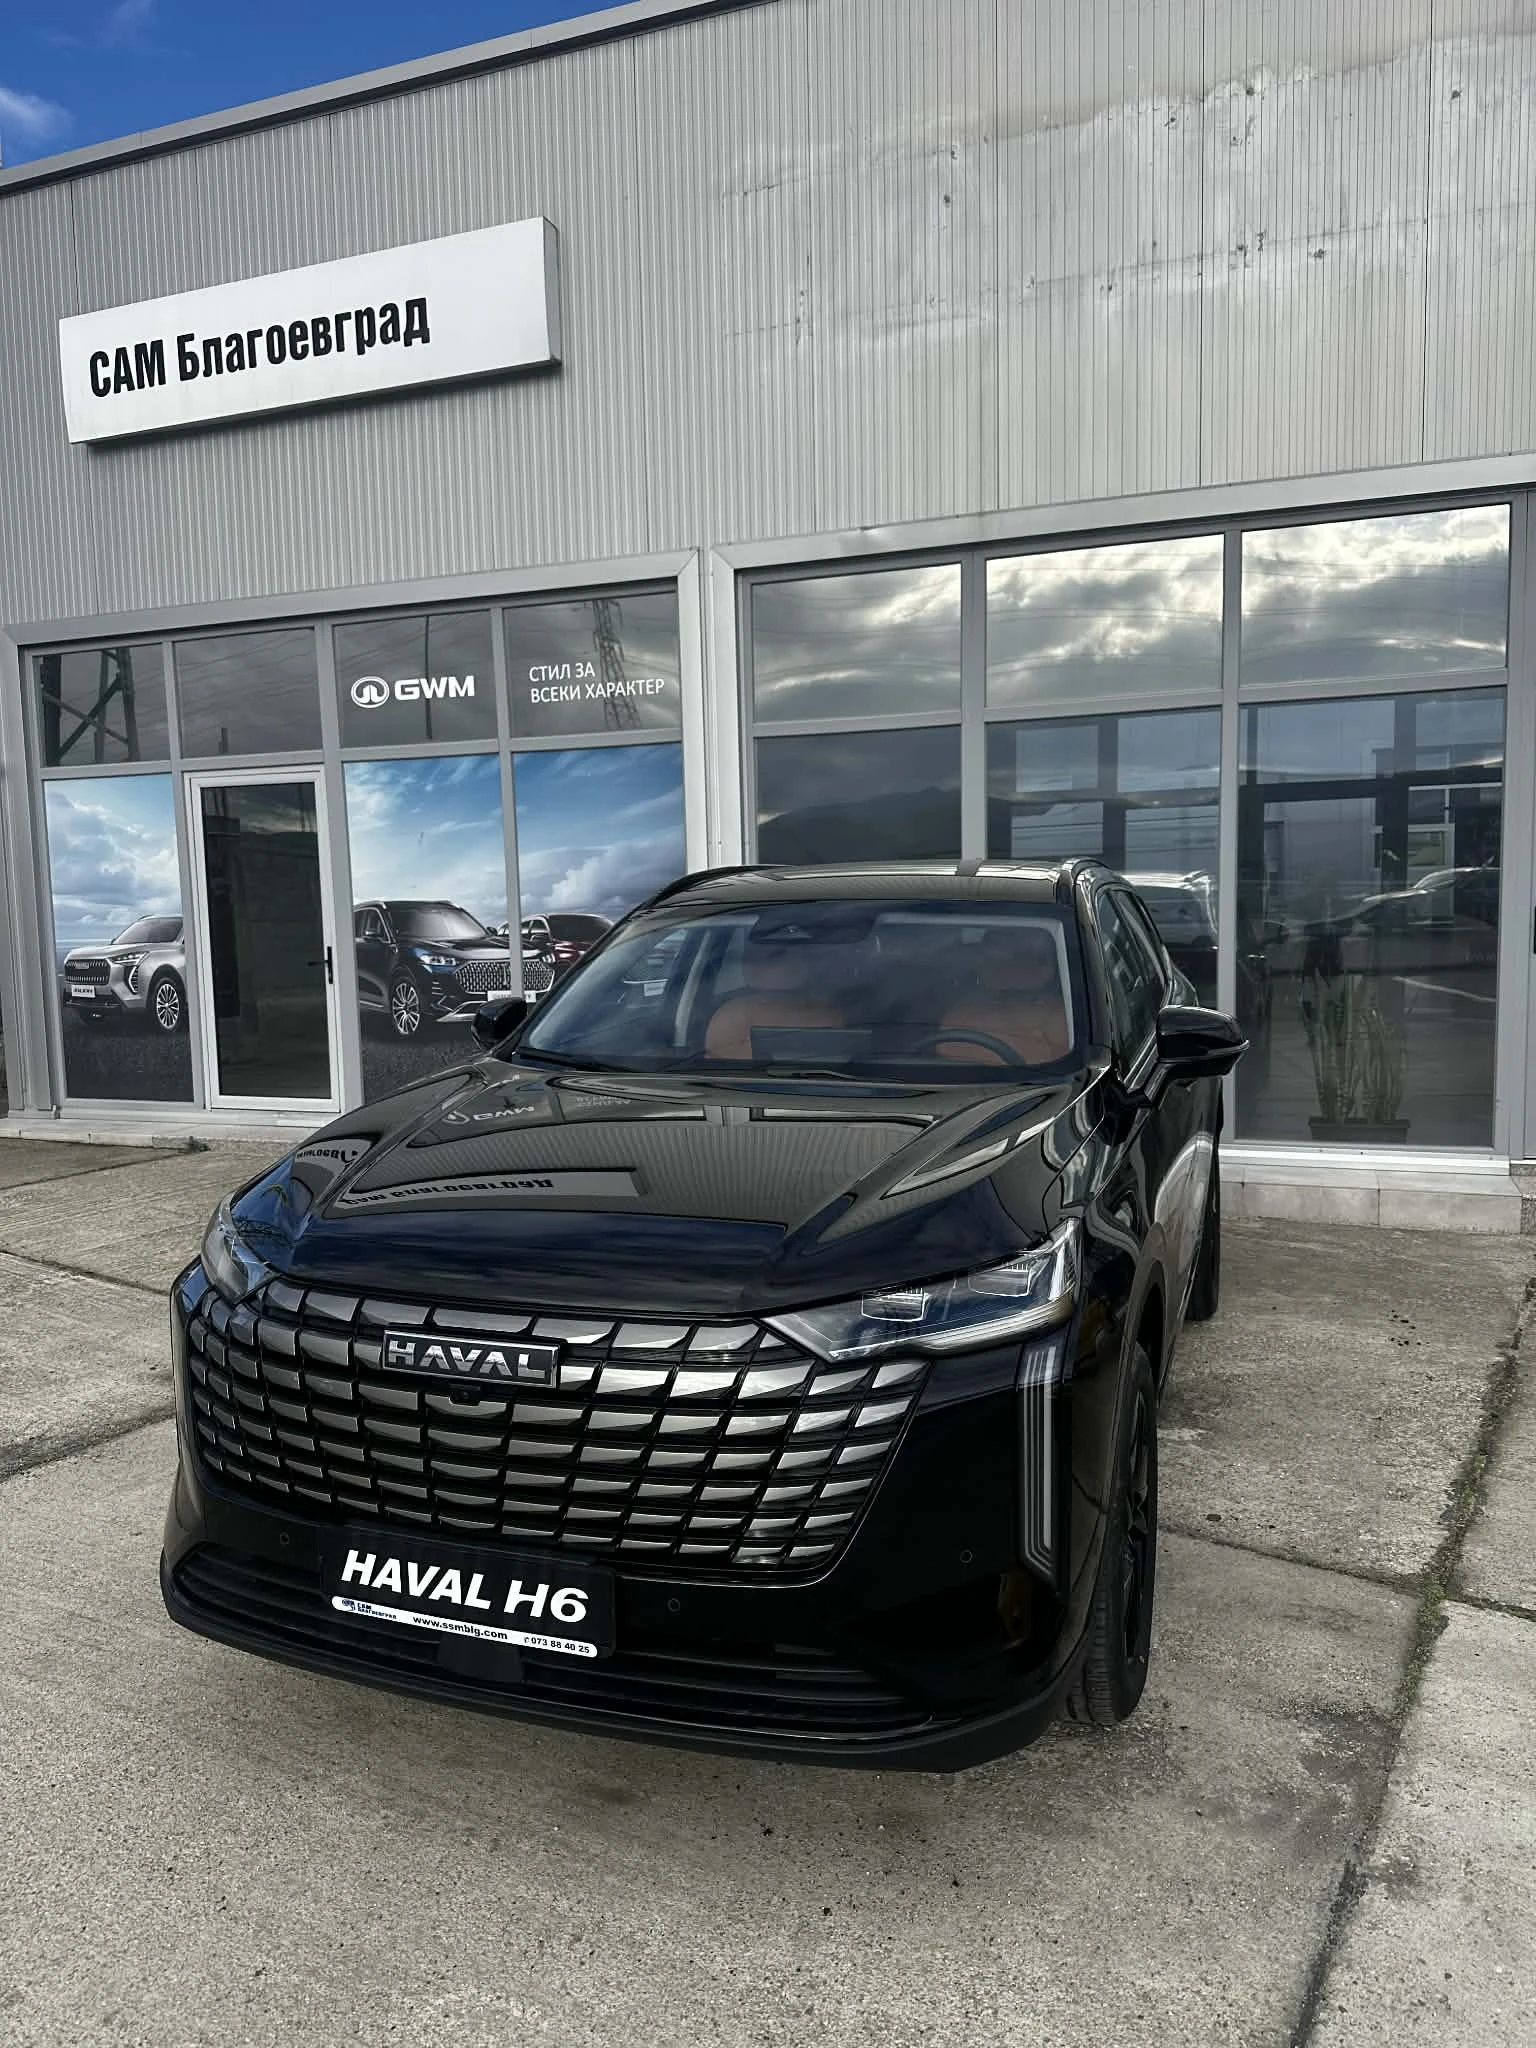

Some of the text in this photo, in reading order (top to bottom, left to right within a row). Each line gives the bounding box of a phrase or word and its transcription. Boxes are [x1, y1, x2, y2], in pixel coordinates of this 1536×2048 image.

[90, 298, 430, 397] САМ Благоевград
[529, 661, 596, 682] СТИЛ ЗА
[395, 676, 475, 700] GWM
[530, 678, 666, 704] ВСЕКИ ХАРАКТЕР
[388, 1340, 546, 1379] HAVAL
[341, 1549, 589, 1623] HAVAL H6
[412, 1615, 508, 1640] www.ssmblg.com
[531, 1636, 590, 1654] 073 88 40 25
